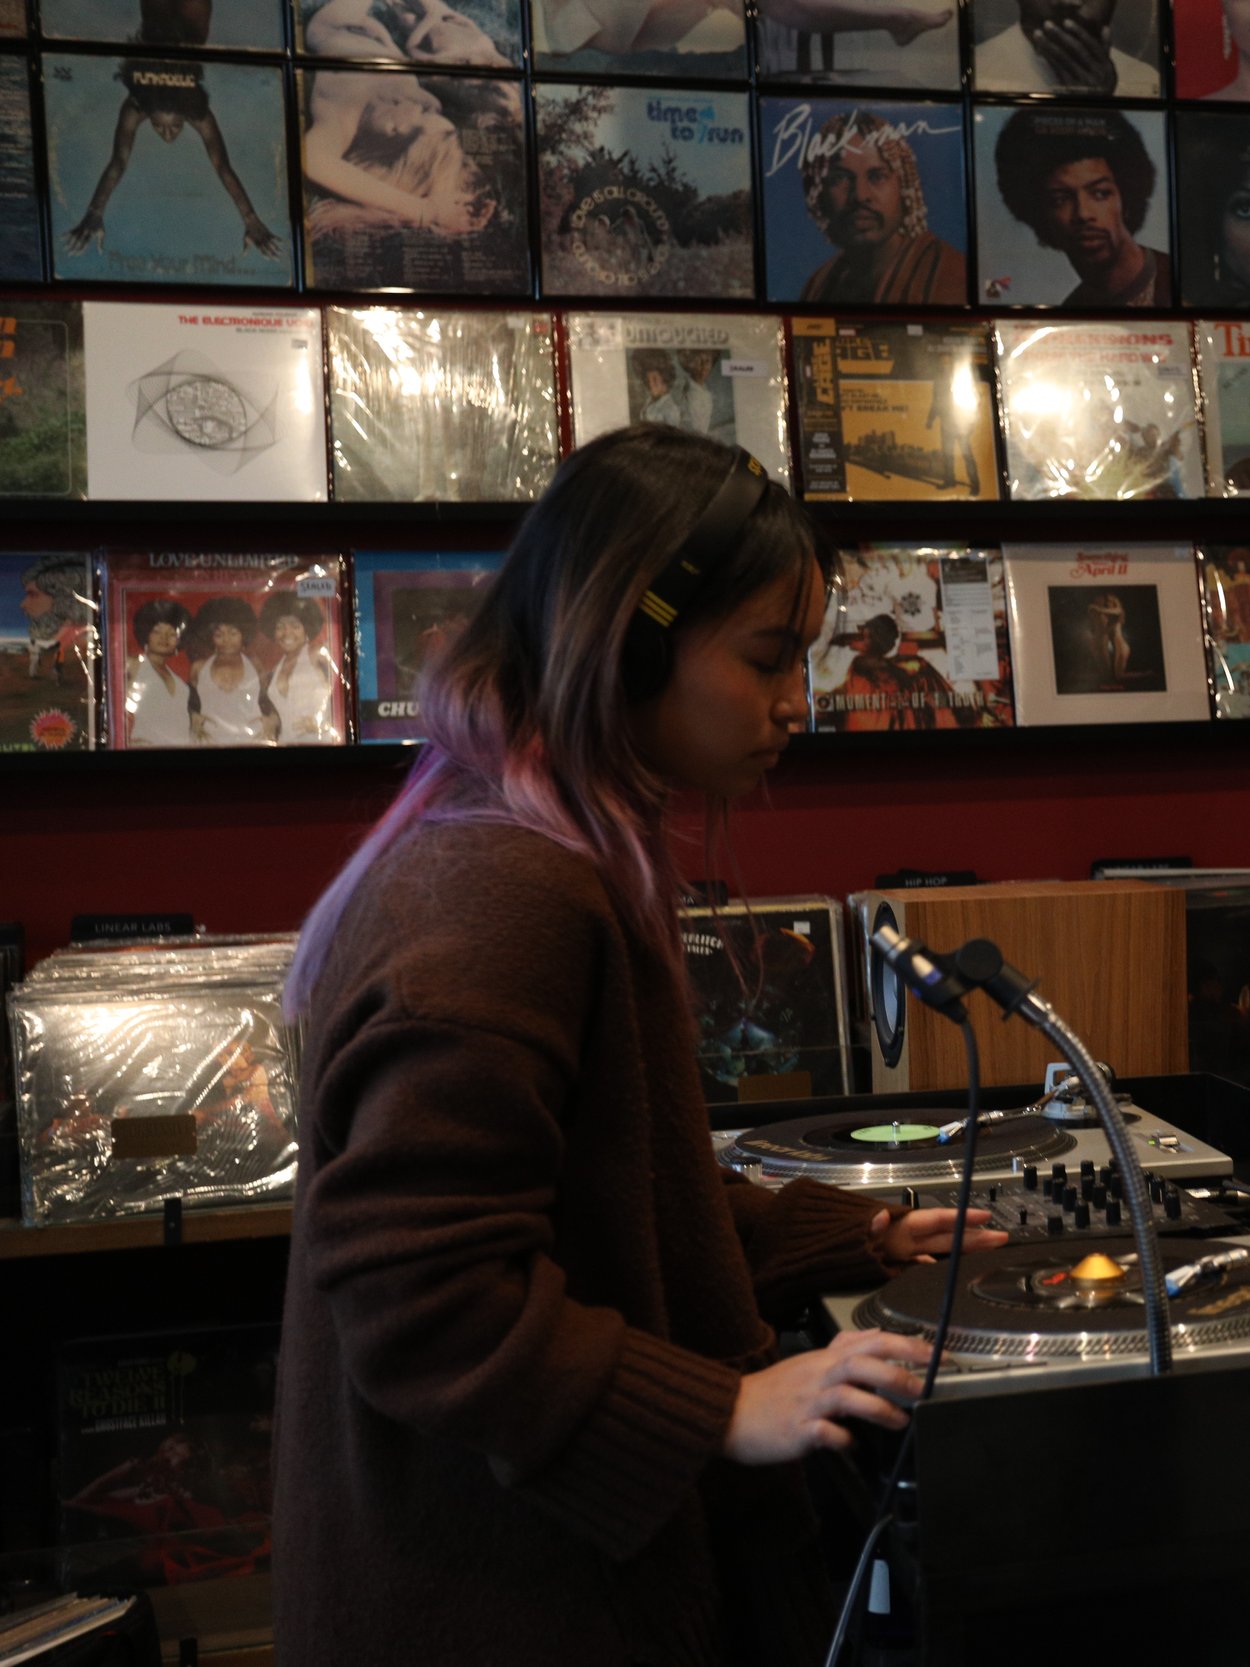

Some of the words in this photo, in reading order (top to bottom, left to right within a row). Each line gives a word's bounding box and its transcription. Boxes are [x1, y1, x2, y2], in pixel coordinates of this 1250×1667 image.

[133, 71, 197, 87] FUNKADELIC
[646, 101, 698, 123] time
[671, 126, 695, 142] to
[707, 128, 743, 144] run
[178, 315, 199, 326] THE
[201, 315, 283, 327] ELECTRONIQUE
[149, 552, 196, 568] LOVE
[1070, 563, 1117, 579] April
[835, 692, 887, 710] MOMENT
[911, 691, 925, 709] OF
[377, 701, 421, 718] CHU
[905, 877, 922, 887] HIP
[925, 876, 948, 887] HOP
[95, 922, 138, 933] LINEAR
[141, 922, 172, 933] LABS
[82, 1367, 162, 1388] TWELVE
[68, 1384, 166, 1408] REASONS
[81, 1402, 107, 1419] TO
[112, 1398, 144, 1415] DIE
